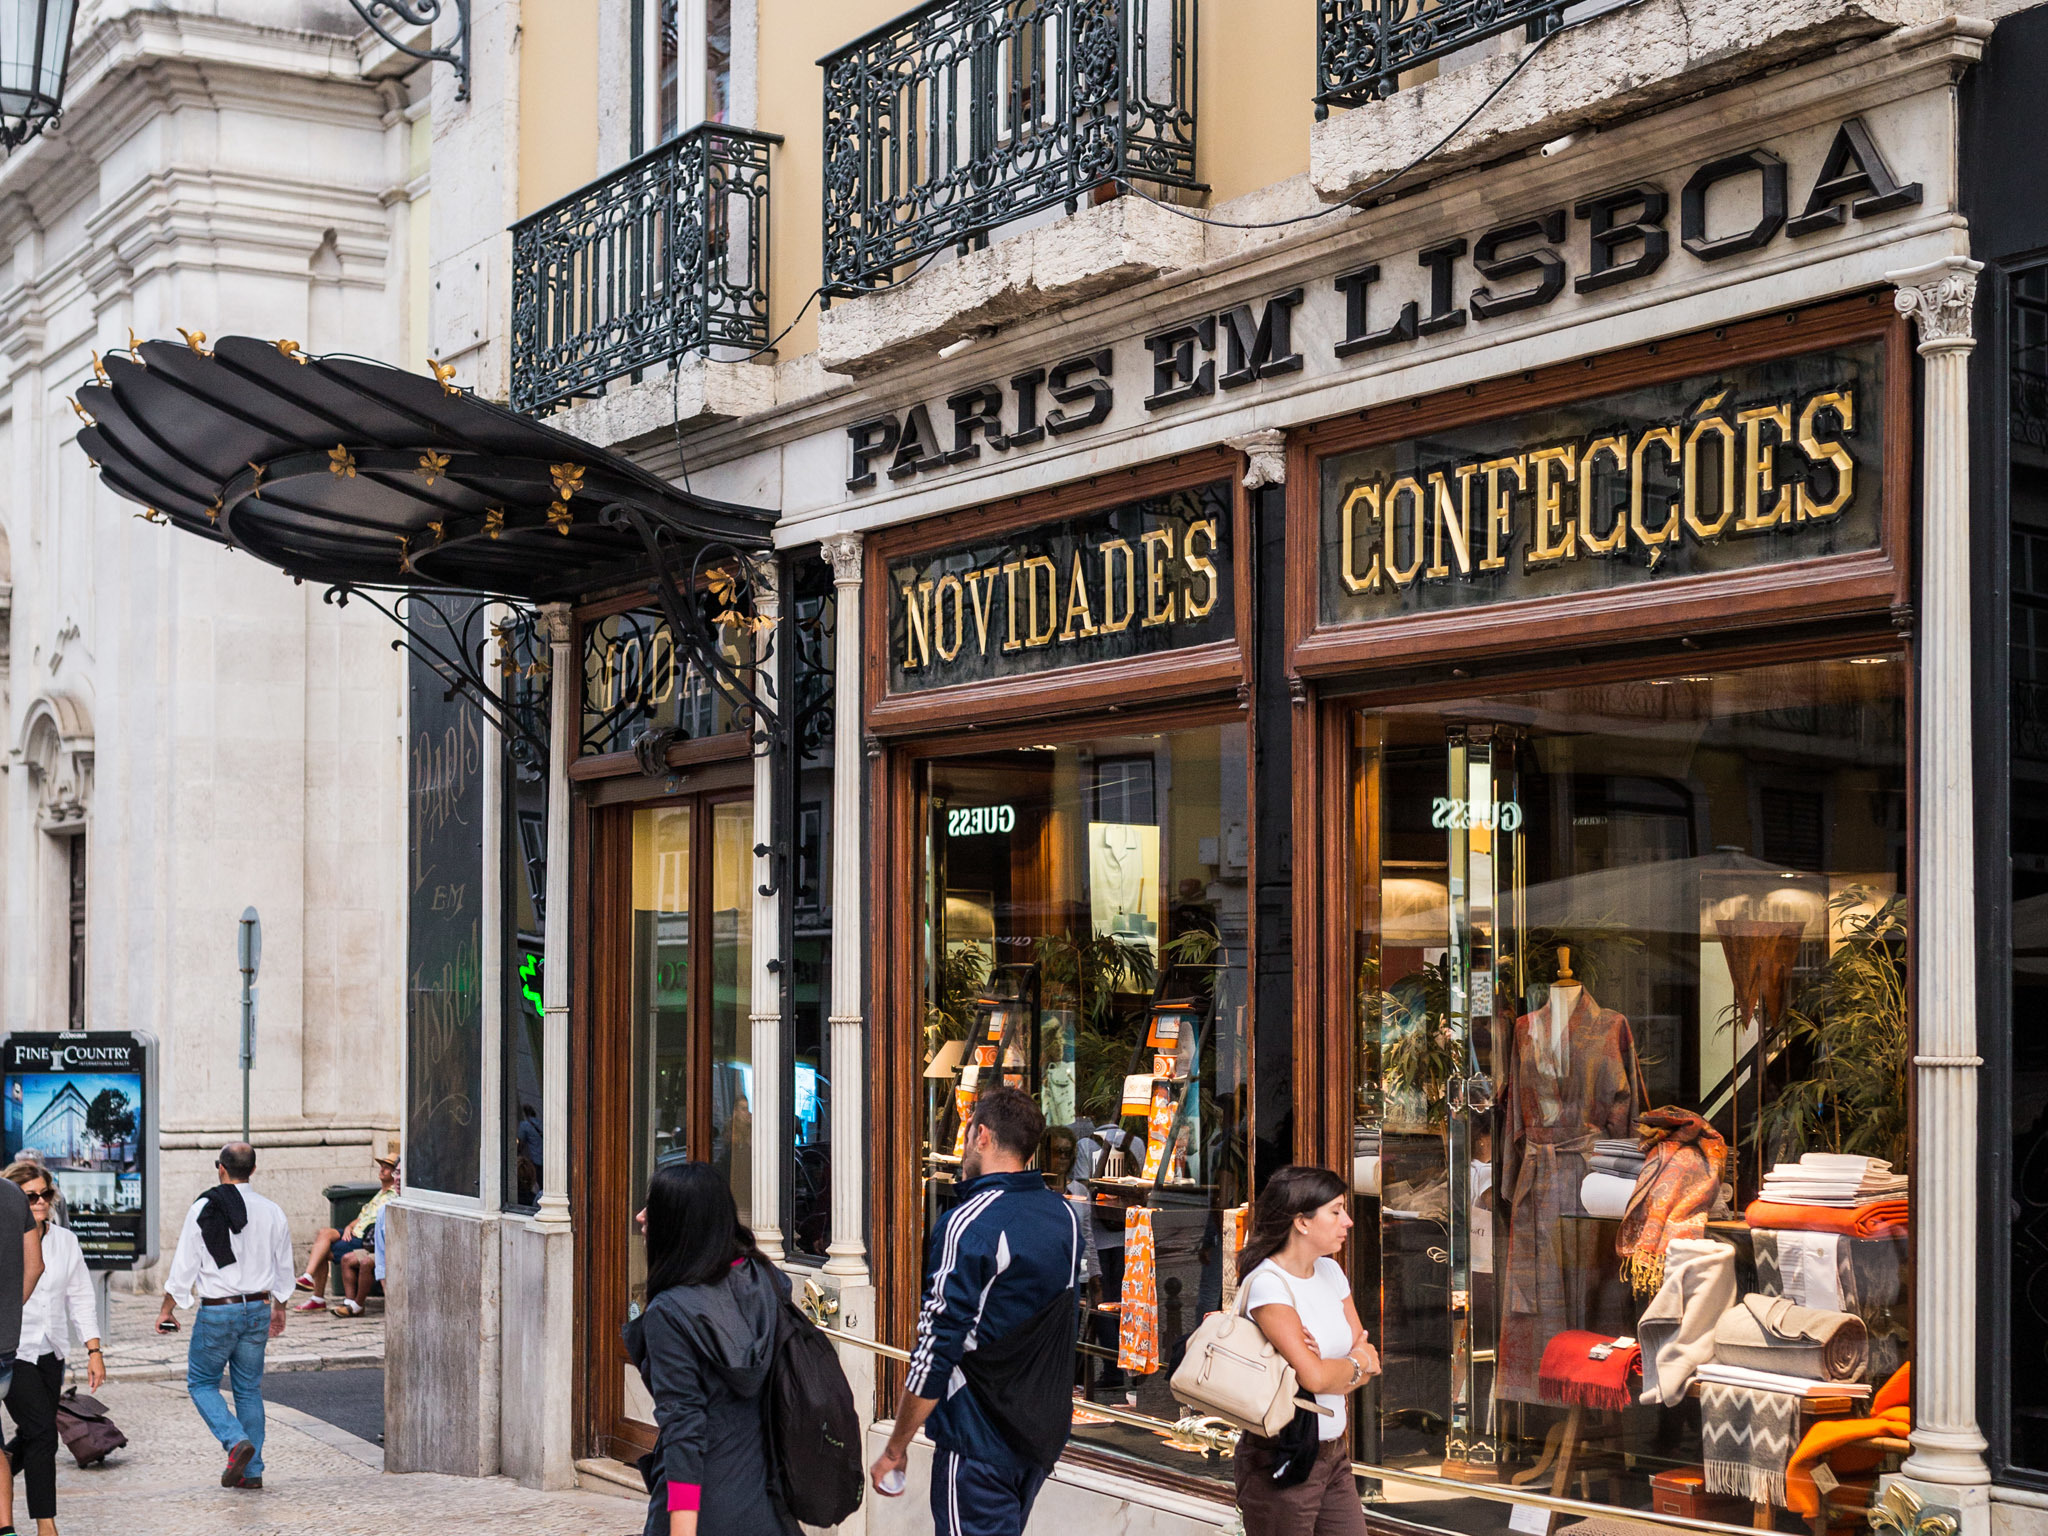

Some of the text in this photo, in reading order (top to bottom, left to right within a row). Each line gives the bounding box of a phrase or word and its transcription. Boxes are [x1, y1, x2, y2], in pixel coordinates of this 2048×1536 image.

[846, 115, 1924, 491] PARIS EM LISBOA
[902, 518, 1219, 669] NOVIDADES
[412, 689, 480, 893] PARIS
[430, 883, 467, 921] EM
[14, 1045, 131, 1065] FINE COUNTRY
[73, 1220, 109, 1228] Apartments
